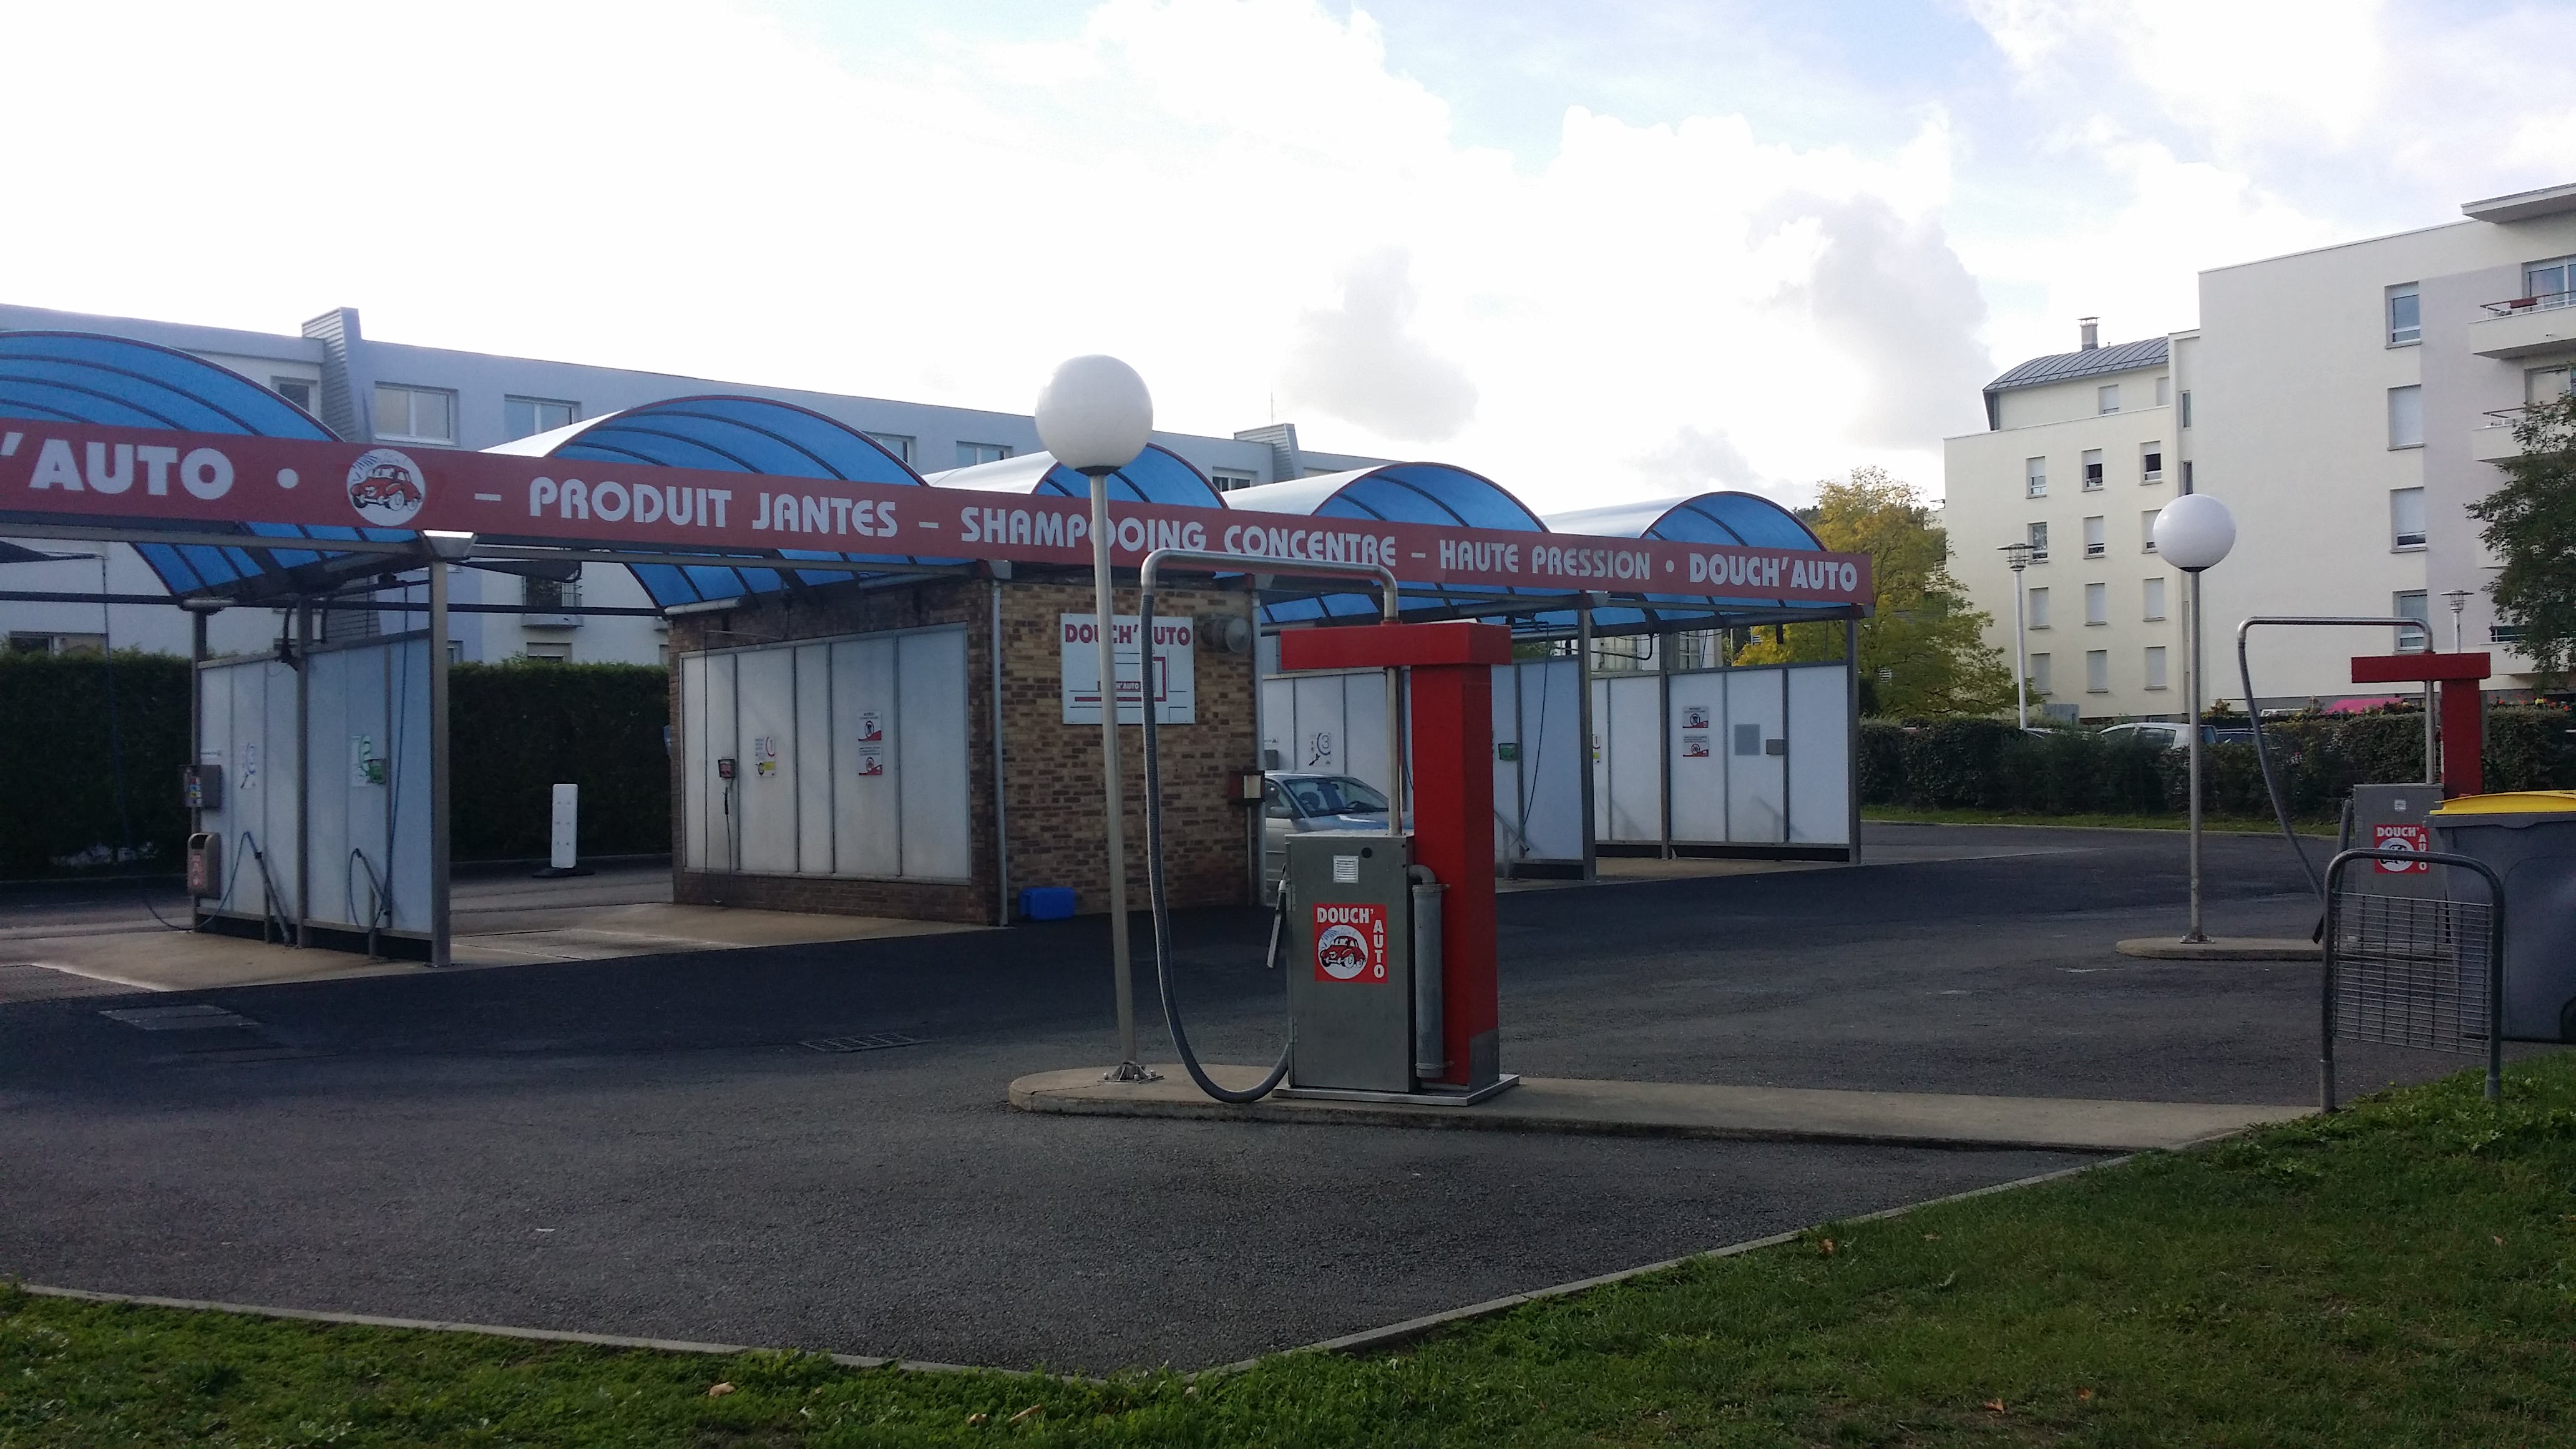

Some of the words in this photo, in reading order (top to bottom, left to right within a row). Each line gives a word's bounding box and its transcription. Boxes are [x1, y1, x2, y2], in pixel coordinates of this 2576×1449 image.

[529, 476, 732, 528] PRODUIT
[752, 492, 898, 537] JANTES
[1224, 525, 1396, 567] CONCENTRE
[1439, 539, 1519, 573] HAUTE
[1531, 545, 1650, 580] PRESSION
[1689, 553, 1858, 592] DOUCH'AUTO
[1065, 624, 1191, 646] DOH'UTO
[2377, 827, 2419, 837] DOUCH'
[2419, 834, 2427, 871] AUO
[1317, 908, 1374, 924] DOUCH'
[1373, 920, 1385, 978] AUTO
